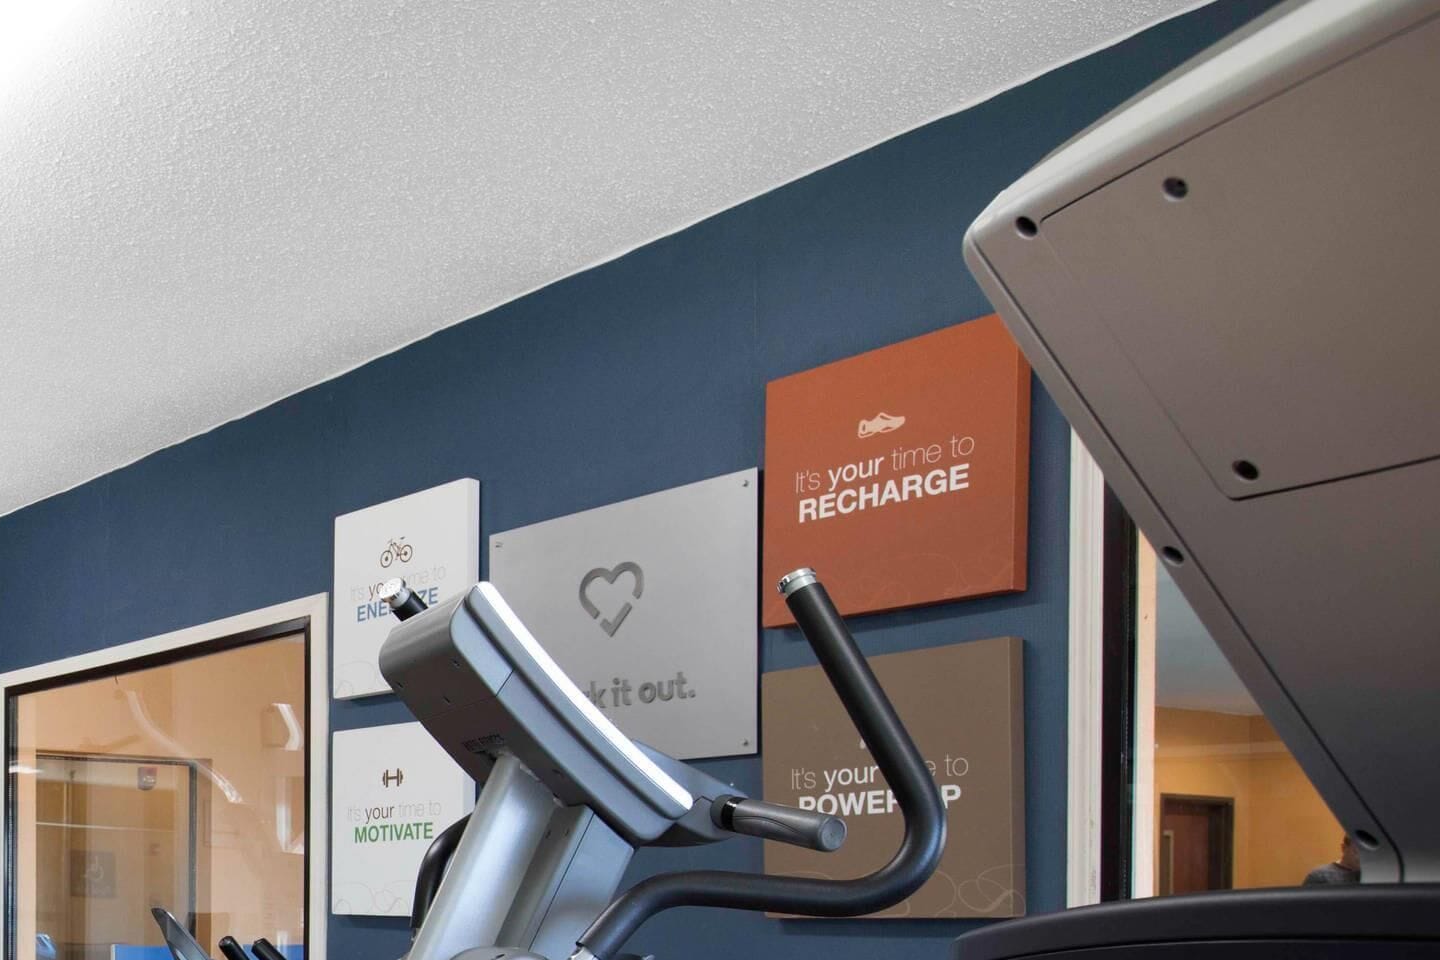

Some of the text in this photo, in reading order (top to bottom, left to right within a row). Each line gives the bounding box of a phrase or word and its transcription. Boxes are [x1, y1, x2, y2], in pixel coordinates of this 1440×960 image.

[795, 434, 975, 494] It's your time to
[798, 463, 971, 524] RECHARGE
[611, 677, 632, 707] it
[638, 671, 696, 704] out.
[791, 767, 817, 791] It's
[823, 765, 879, 792] your
[944, 752, 969, 777] to
[365, 805, 395, 825] your
[398, 800, 425, 818] time
[429, 799, 442, 817] to
[354, 822, 434, 844] MOTIVATE
